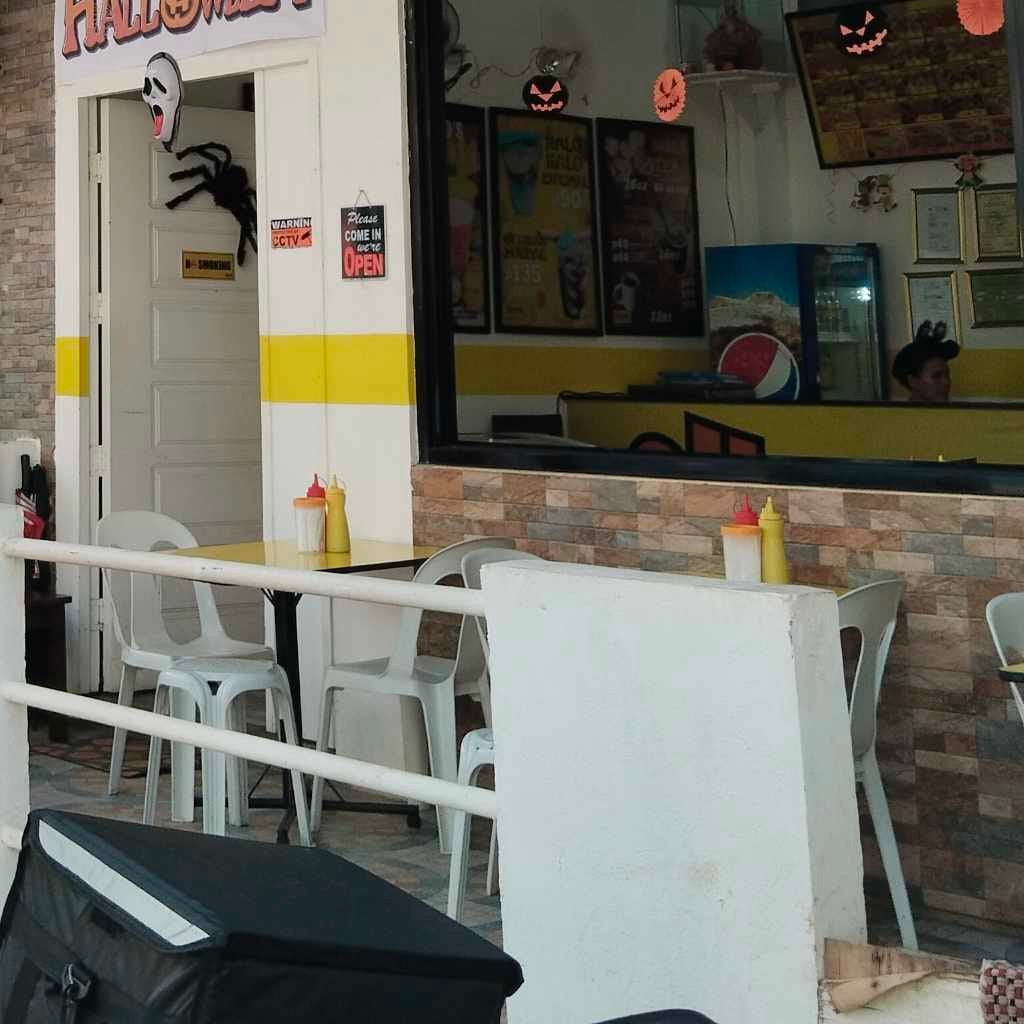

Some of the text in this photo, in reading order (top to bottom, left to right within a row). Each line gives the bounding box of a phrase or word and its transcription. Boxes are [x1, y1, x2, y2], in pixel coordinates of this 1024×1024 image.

[347, 211, 379, 224] Please
[344, 228, 382, 242] COME IN
[357, 242, 382, 253] we're
[344, 247, 384, 277] OPEN
